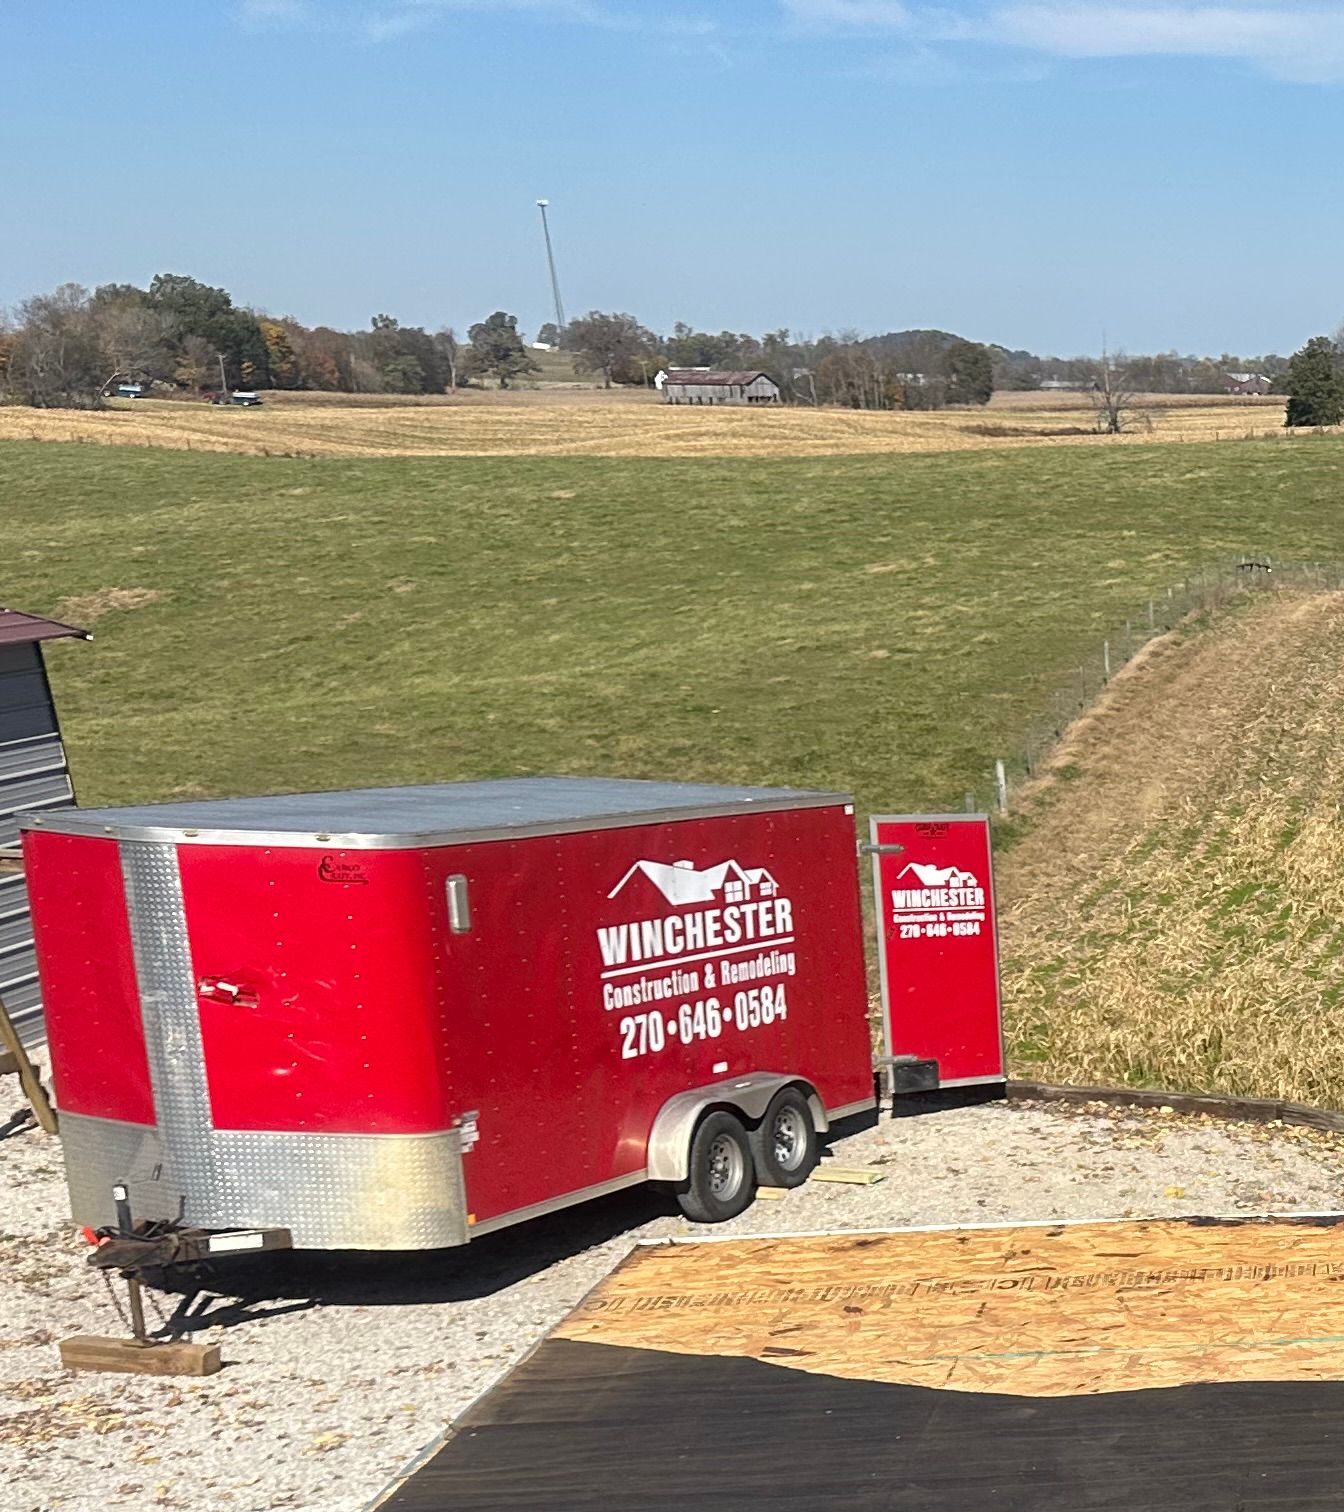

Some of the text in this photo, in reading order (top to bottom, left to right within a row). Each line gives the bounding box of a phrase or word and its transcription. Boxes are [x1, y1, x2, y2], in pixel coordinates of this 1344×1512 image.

[891, 887, 985, 908] WINCHESTER
[596, 897, 794, 966] WINCHESTER
[603, 950, 796, 1011] Construction & Remodeling
